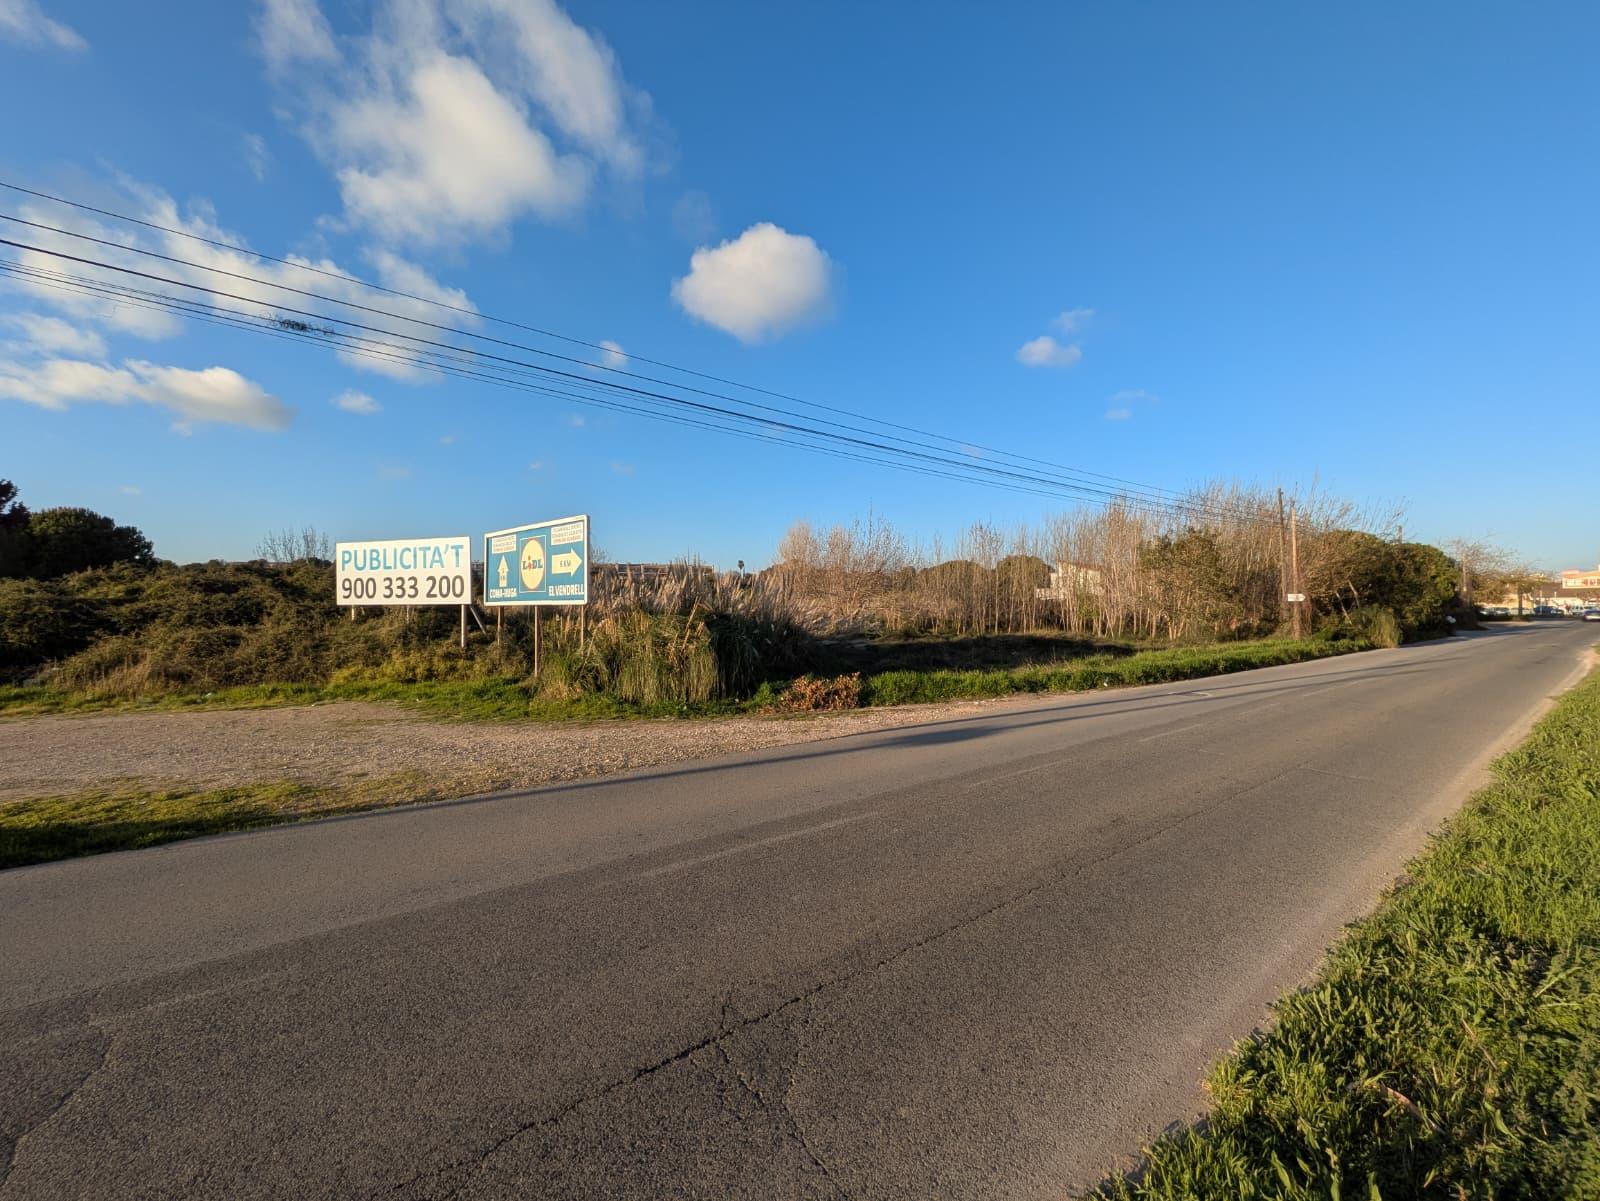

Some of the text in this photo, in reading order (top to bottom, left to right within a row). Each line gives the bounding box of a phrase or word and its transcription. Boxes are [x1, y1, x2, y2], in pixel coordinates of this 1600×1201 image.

[341, 544, 464, 571] PUBLICITA'T
[341, 575, 465, 599] 900 333 200
[549, 584, 584, 596] EL VENDRELL
